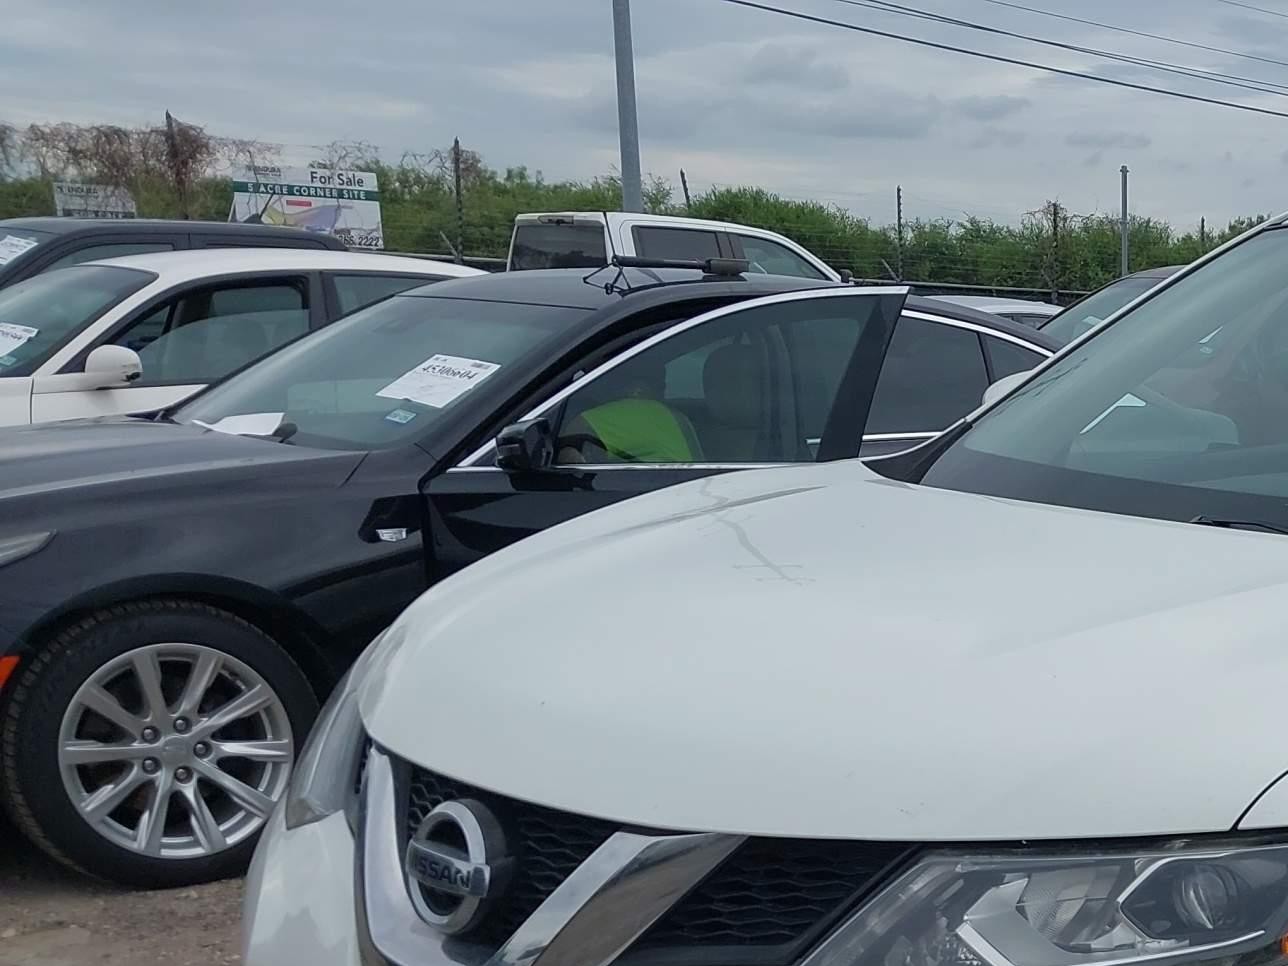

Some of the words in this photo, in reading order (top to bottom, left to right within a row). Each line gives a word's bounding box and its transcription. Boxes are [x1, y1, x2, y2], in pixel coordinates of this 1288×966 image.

[309, 170, 332, 185] For
[337, 172, 364, 188] Sale
[247, 183, 254, 192] 5
[259, 184, 289, 194] ACRE
[293, 186, 338, 198] CORNER
[343, 189, 366, 200] SITE
[412, 851, 471, 888] SSAN
